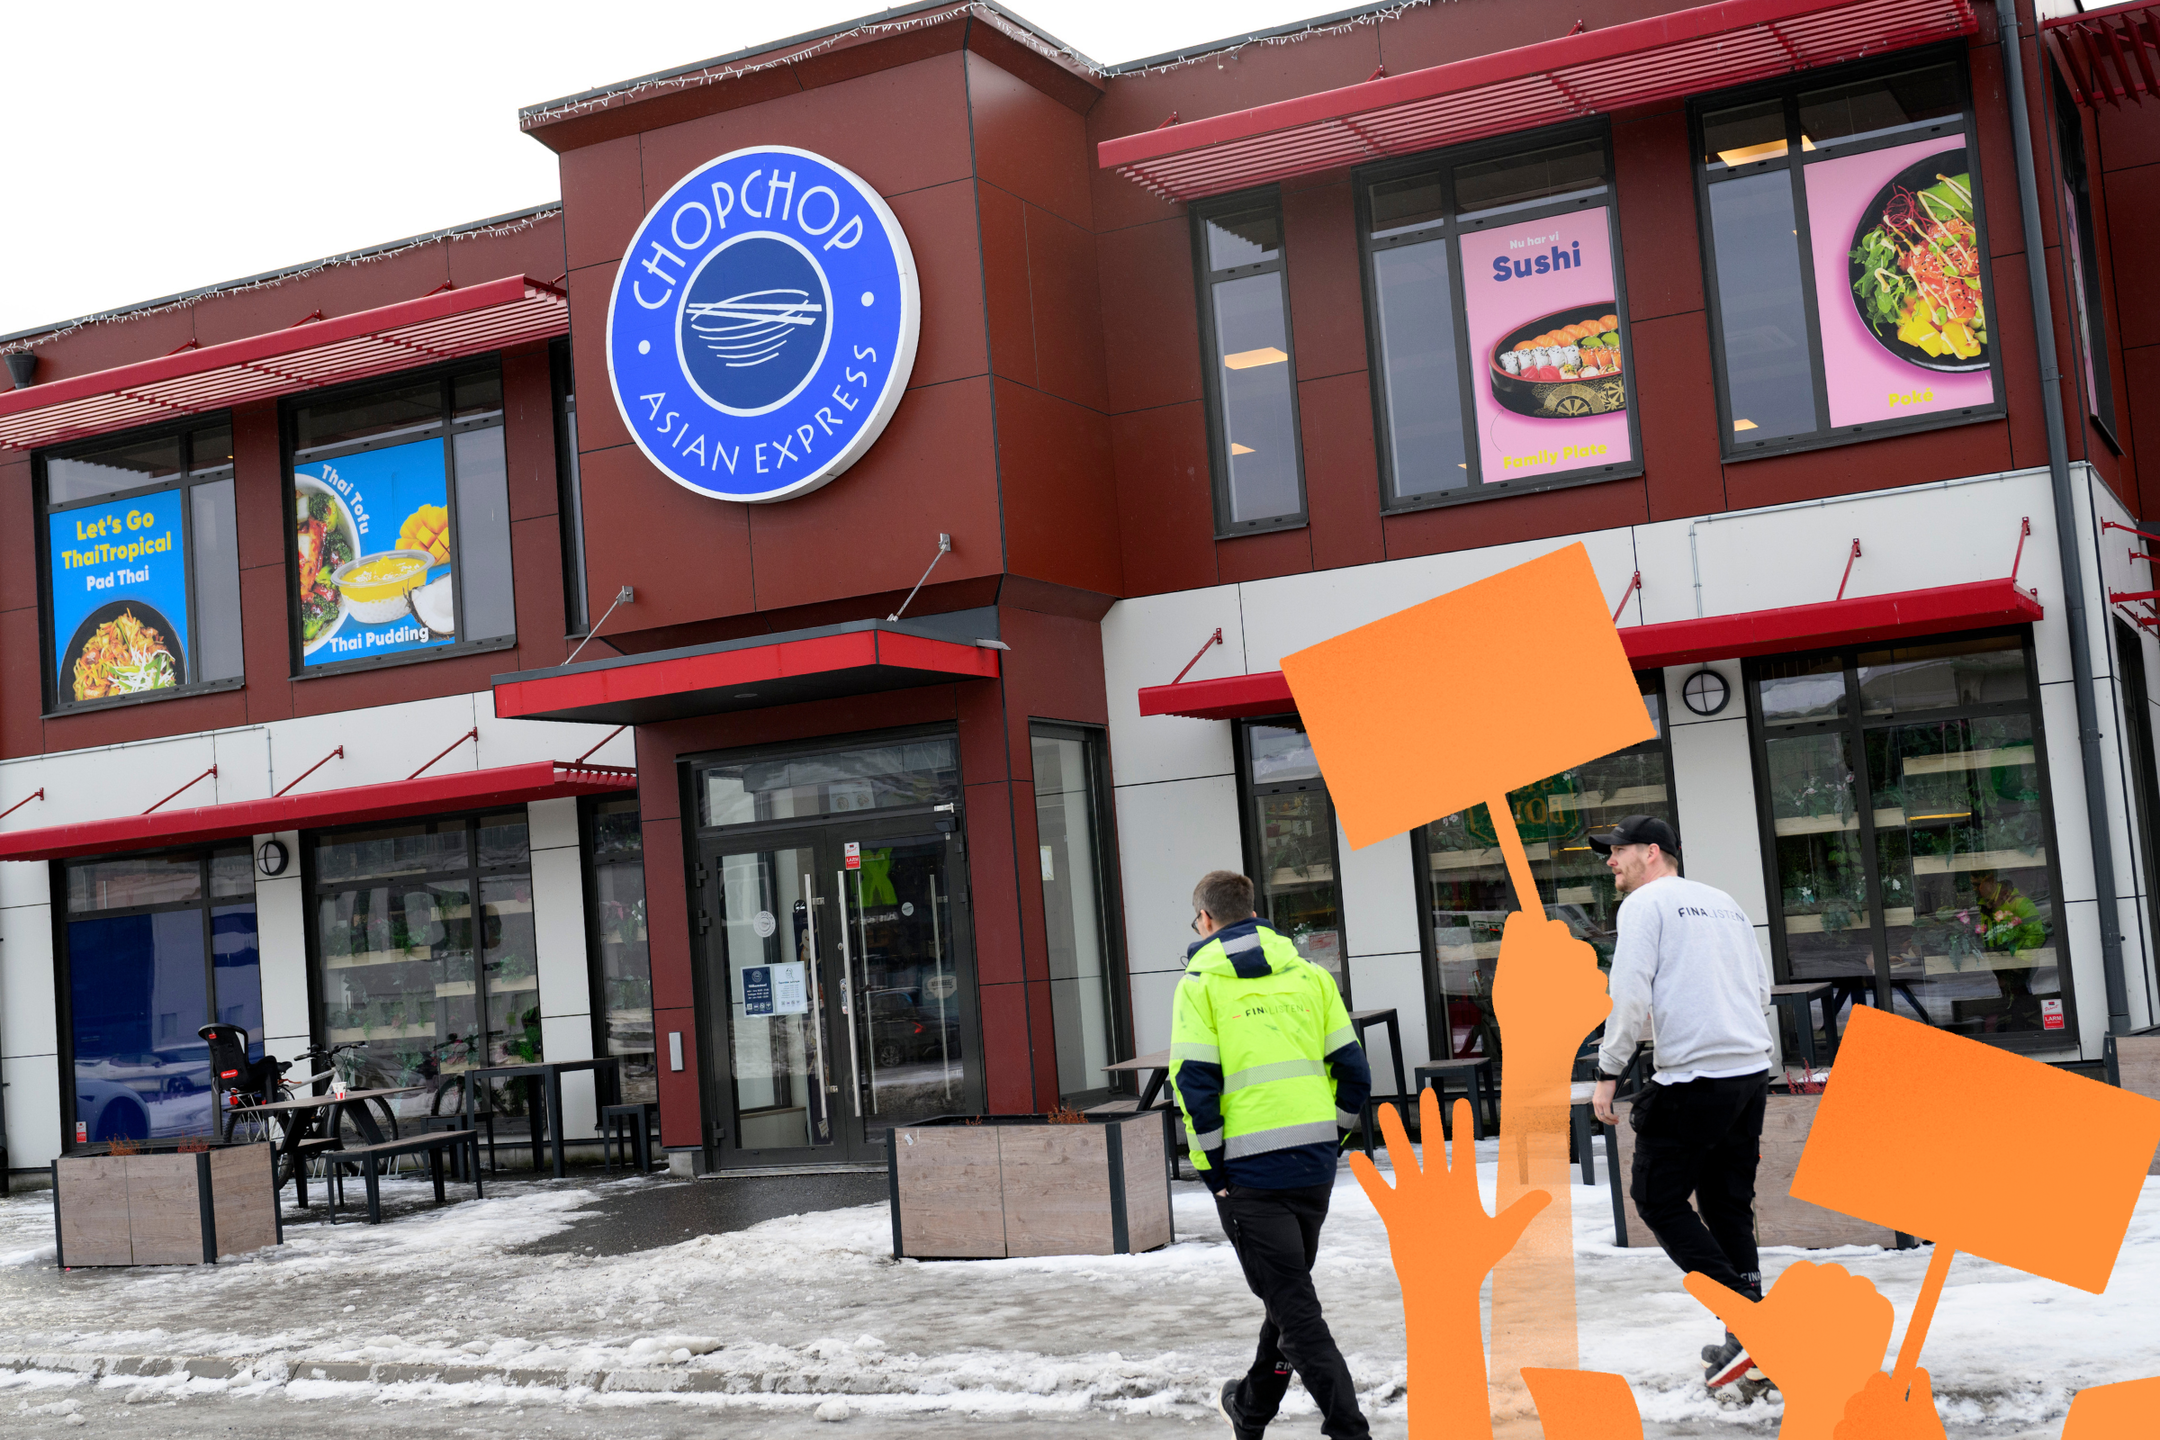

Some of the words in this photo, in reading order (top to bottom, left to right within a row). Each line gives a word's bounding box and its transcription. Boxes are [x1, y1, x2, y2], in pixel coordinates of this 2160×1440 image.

[633, 168, 864, 310] CHOPCHOP
[1509, 240, 1525, 249] Nu
[1527, 236, 1546, 246] har
[1549, 231, 1559, 241] vi
[1492, 240, 1581, 282] Sushi
[639, 390, 740, 476] ASIAN
[754, 343, 878, 475] EXPRESS
[1888, 387, 1934, 408] Poké
[1503, 449, 1558, 469] Family
[1563, 443, 1608, 460] Plate
[322, 463, 354, 497] Thai
[350, 491, 370, 535] Tofu
[76, 515, 122, 541] Let's
[126, 509, 154, 531] Go
[61, 531, 172, 570] ThaiTropical
[86, 571, 114, 592] Pad
[117, 564, 150, 586] Thai
[329, 633, 362, 653] Thai
[365, 625, 429, 644] Pudding
[1677, 906, 1745, 923] FINALISTEN
